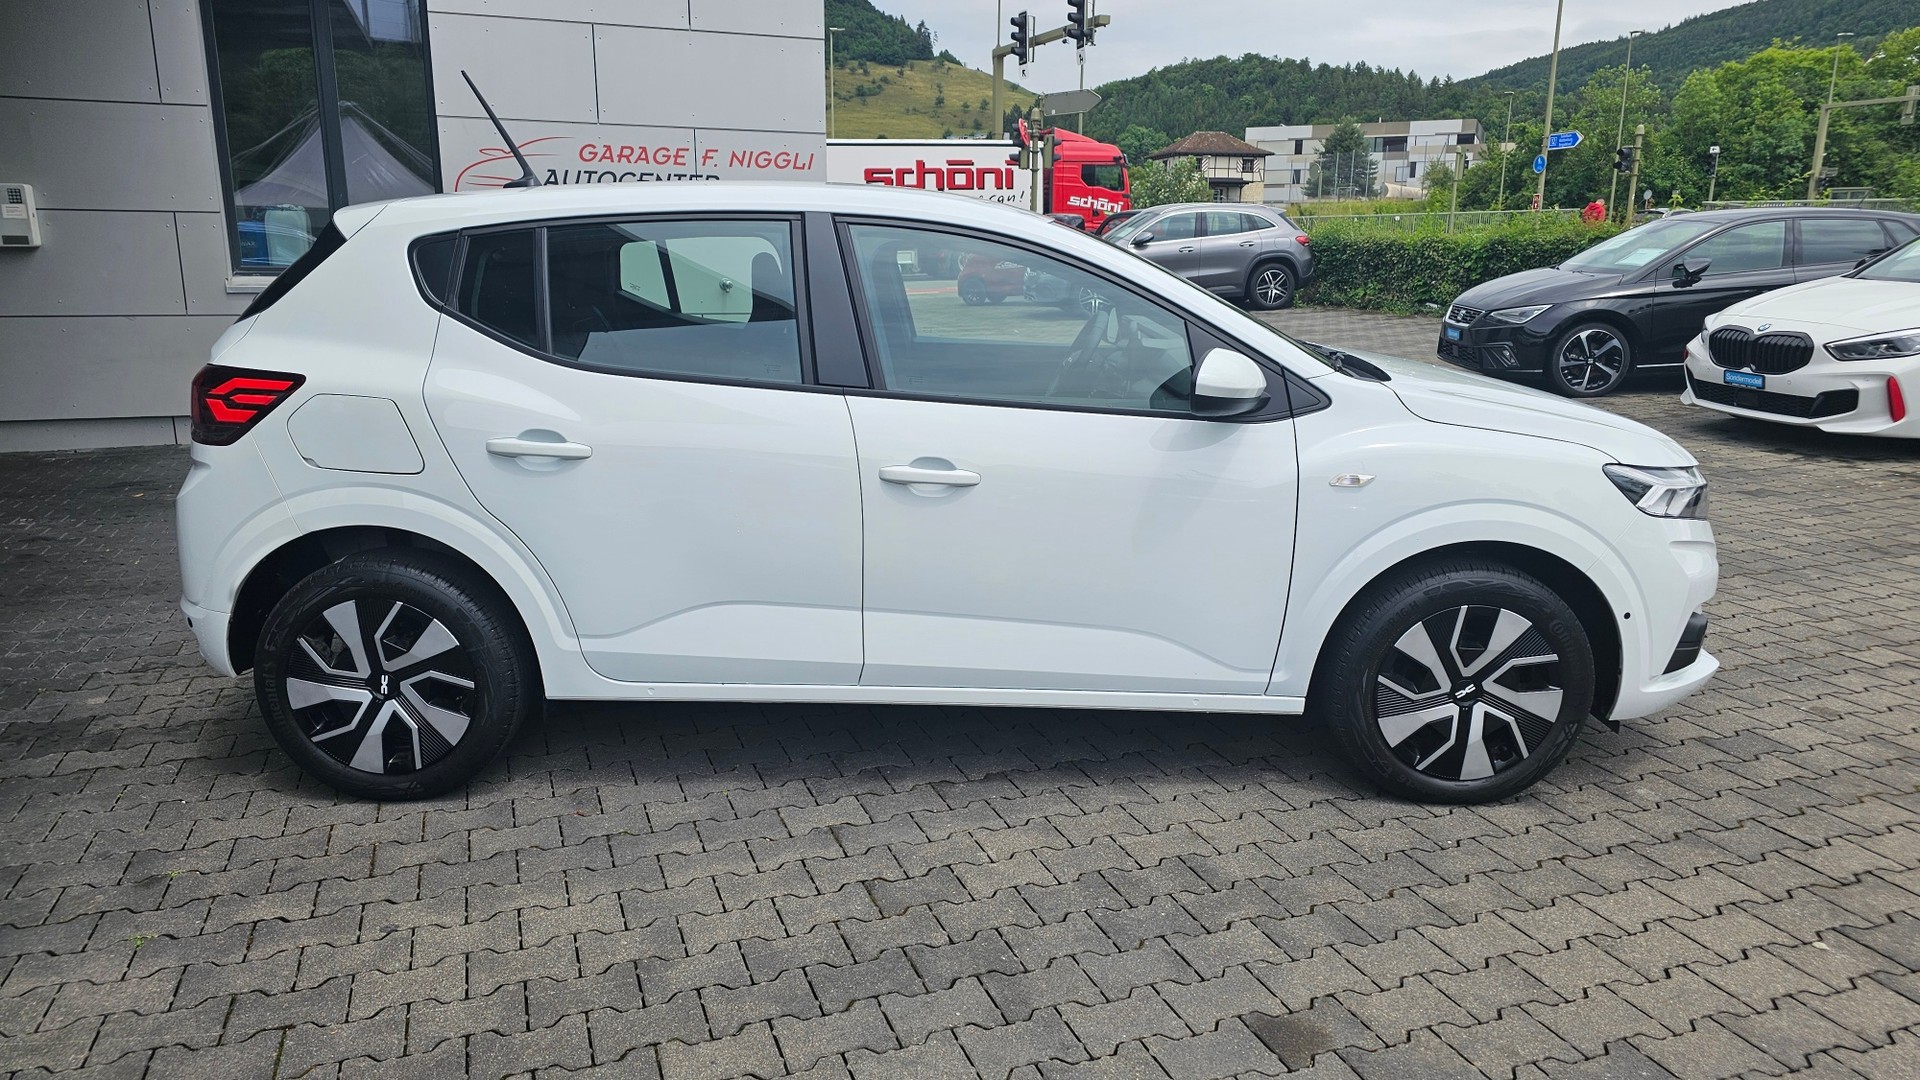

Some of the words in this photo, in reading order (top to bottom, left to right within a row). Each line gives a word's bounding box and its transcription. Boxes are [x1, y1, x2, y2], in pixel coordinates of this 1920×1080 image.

[579, 143, 690, 167] GARAGE
[701, 149, 719, 168] F.
[728, 150, 815, 170] NIGGLI
[543, 168, 721, 186] AUTOCE
